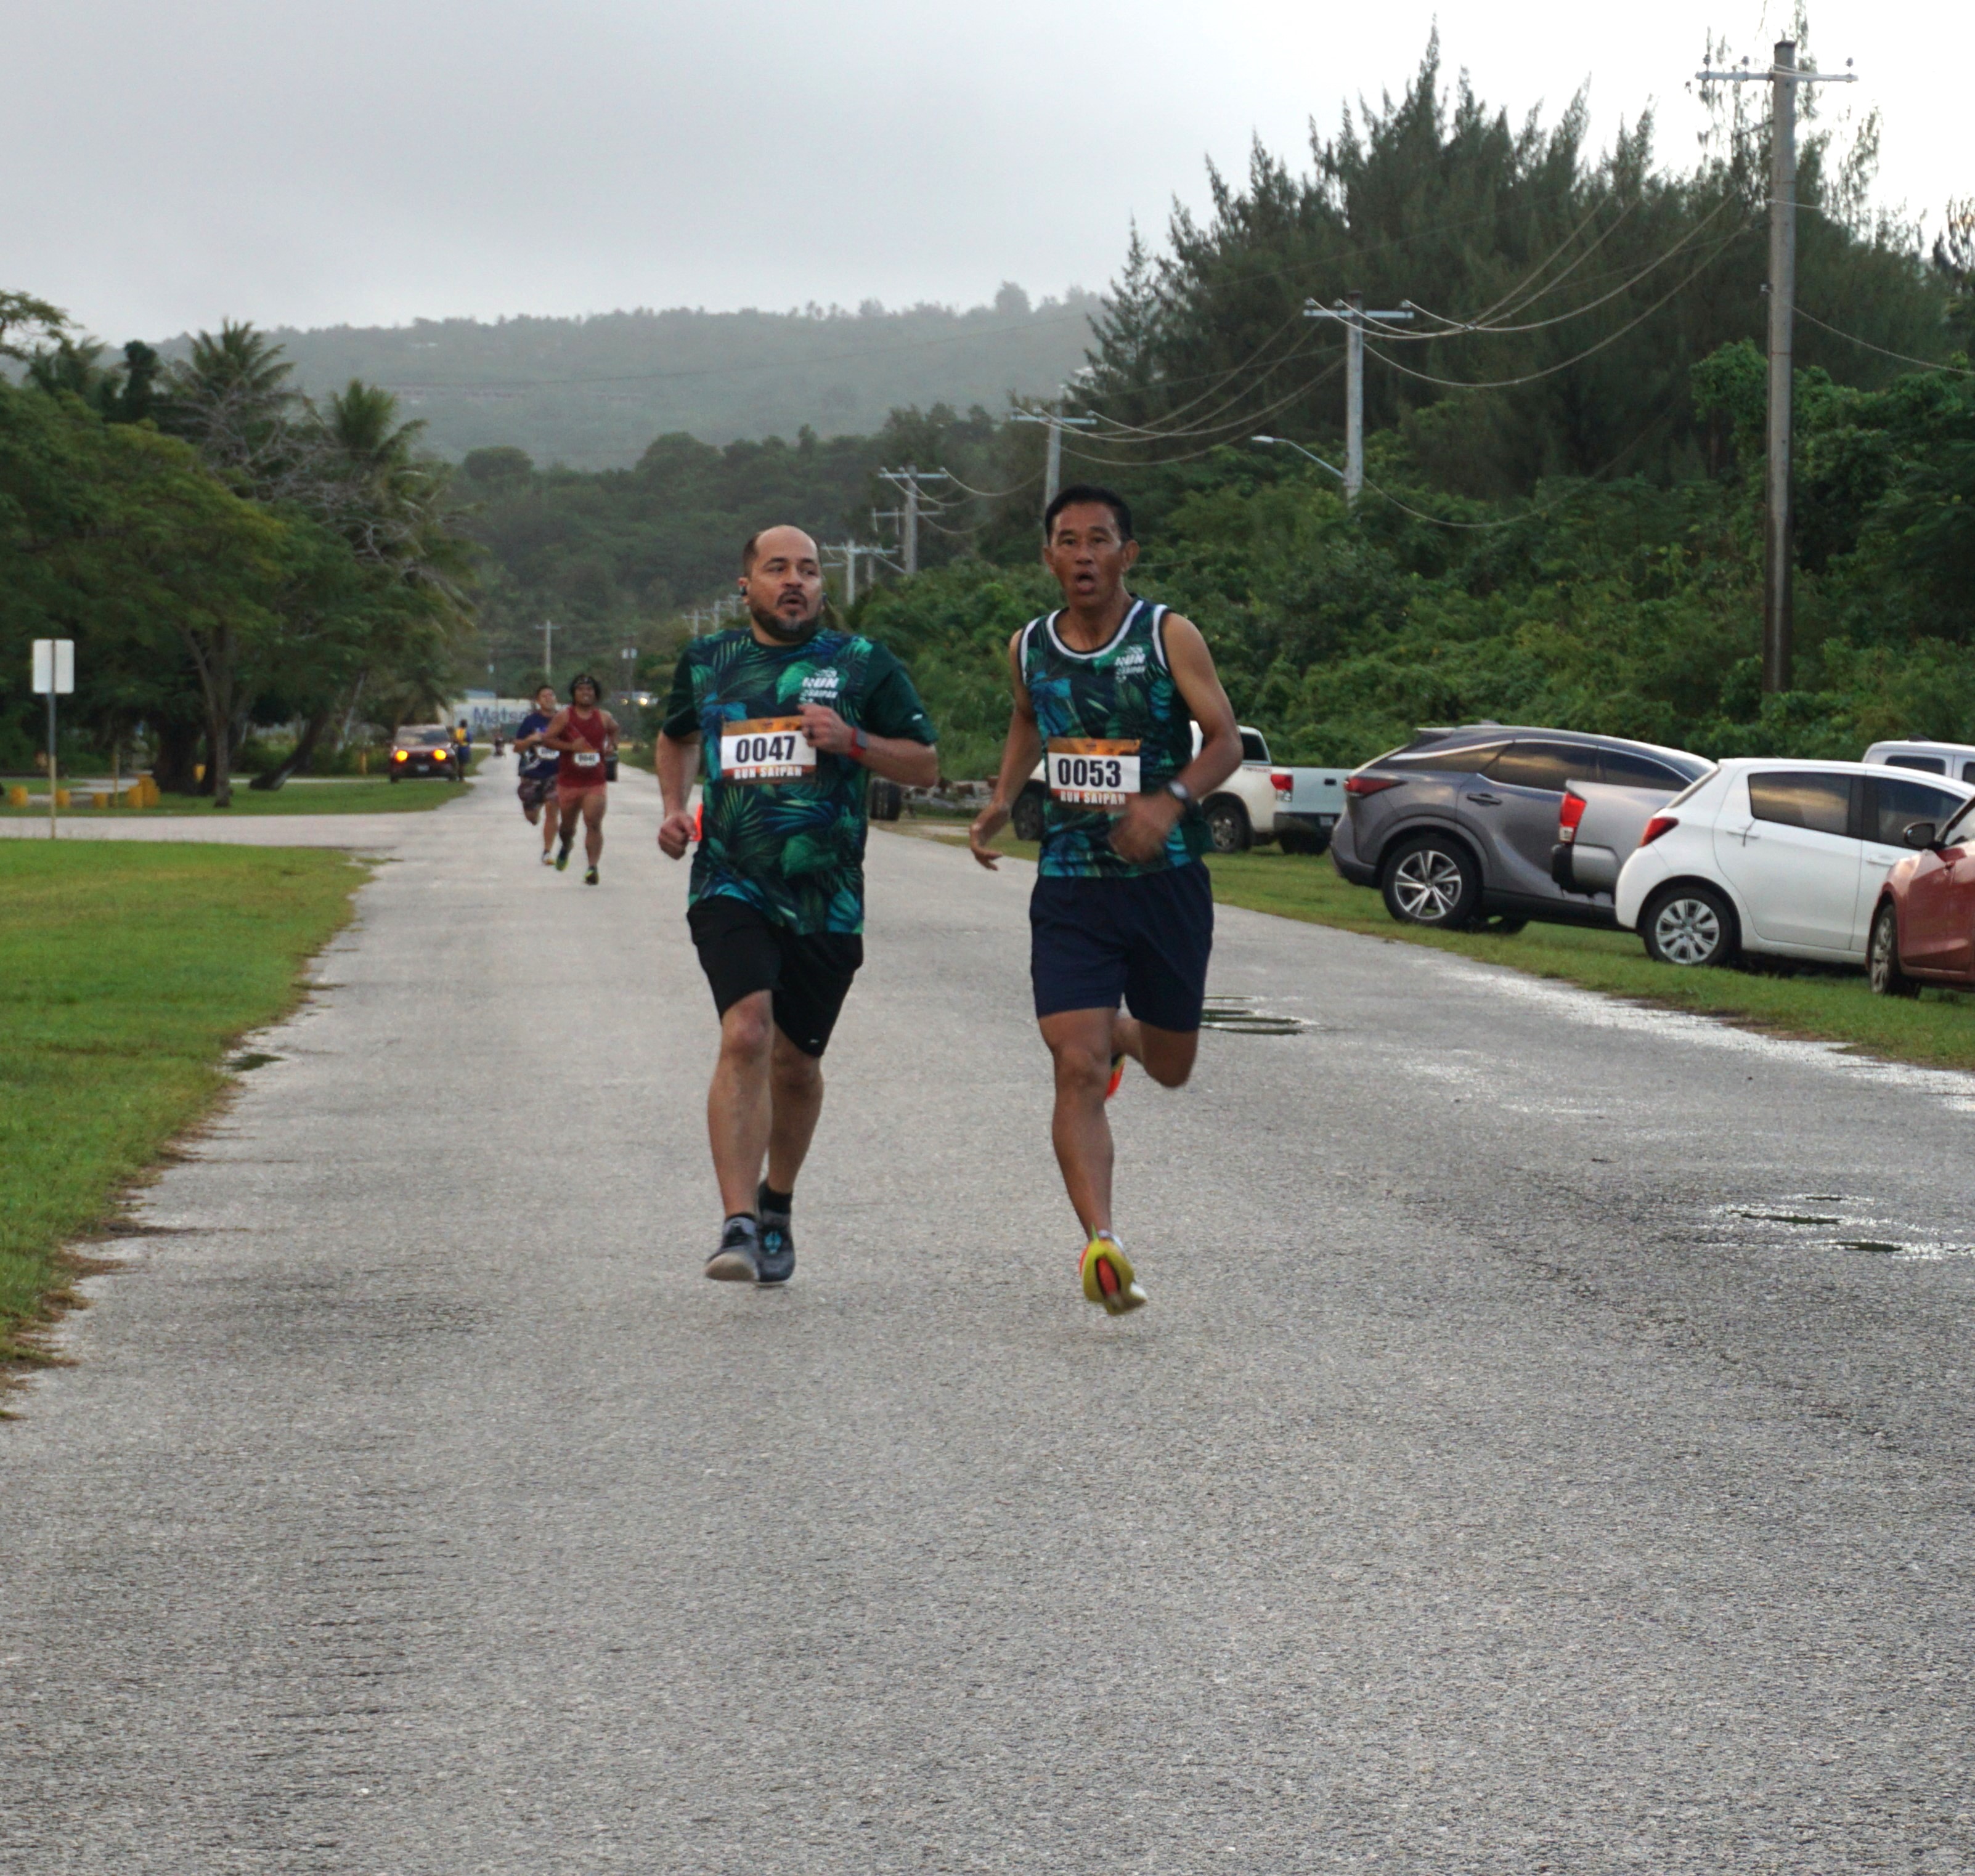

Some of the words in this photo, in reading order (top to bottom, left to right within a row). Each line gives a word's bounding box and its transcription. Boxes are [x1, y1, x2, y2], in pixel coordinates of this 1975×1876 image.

[736, 736, 796, 763] 0047
[733, 768, 756, 780] RUN
[759, 766, 802, 778] SAIPAN
[1057, 758, 1122, 788] 0053
[1060, 790, 1080, 803] RUN
[1083, 791, 1126, 805] SAIPAN
